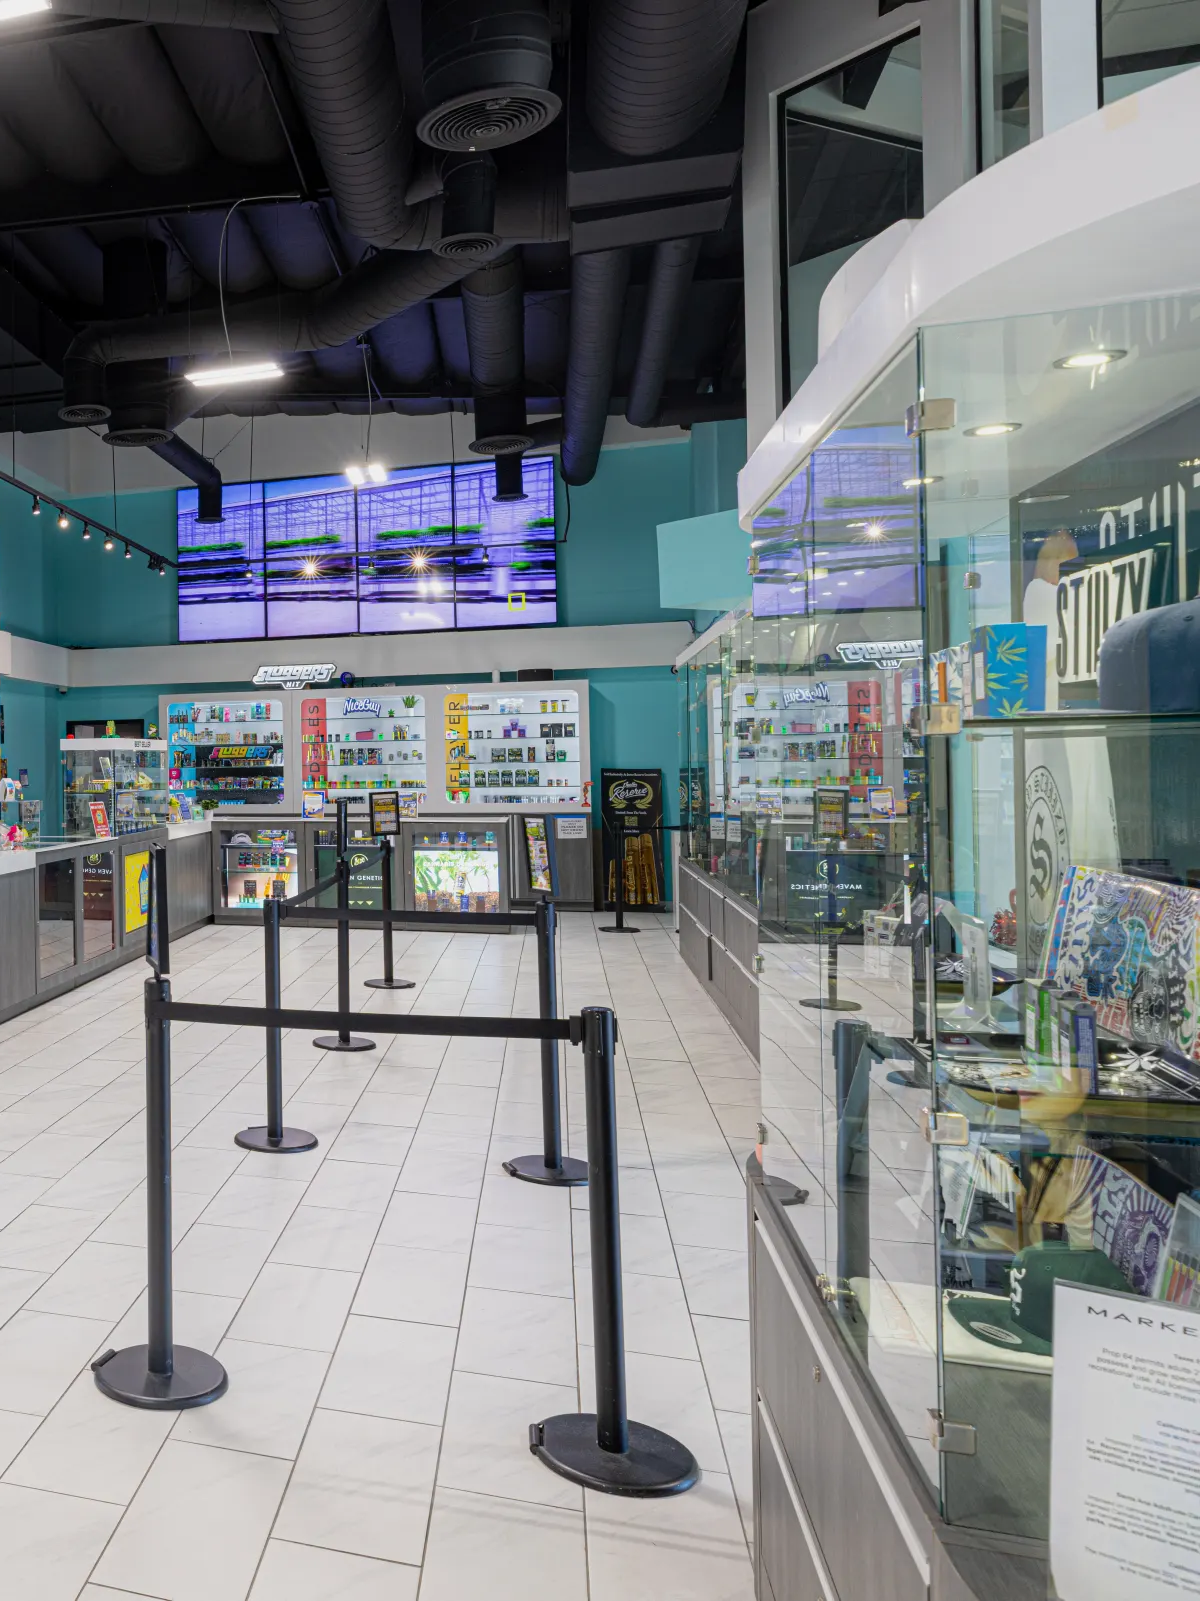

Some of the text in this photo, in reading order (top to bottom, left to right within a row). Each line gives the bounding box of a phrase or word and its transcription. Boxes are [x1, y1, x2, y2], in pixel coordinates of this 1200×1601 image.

[253, 664, 336, 683] SLUGGERS
[343, 697, 381, 718] NiceGuy
[448, 701, 462, 783] FLOER
[210, 746, 271, 759] SLUGGERS
[609, 786, 648, 801] Reserve
[1102, 1347, 1120, 1358] Prop
[1123, 1352, 1132, 1360] 64
[1088, 1363, 1133, 1378] recreational
[1097, 1357, 1168, 1379] possess and grow
